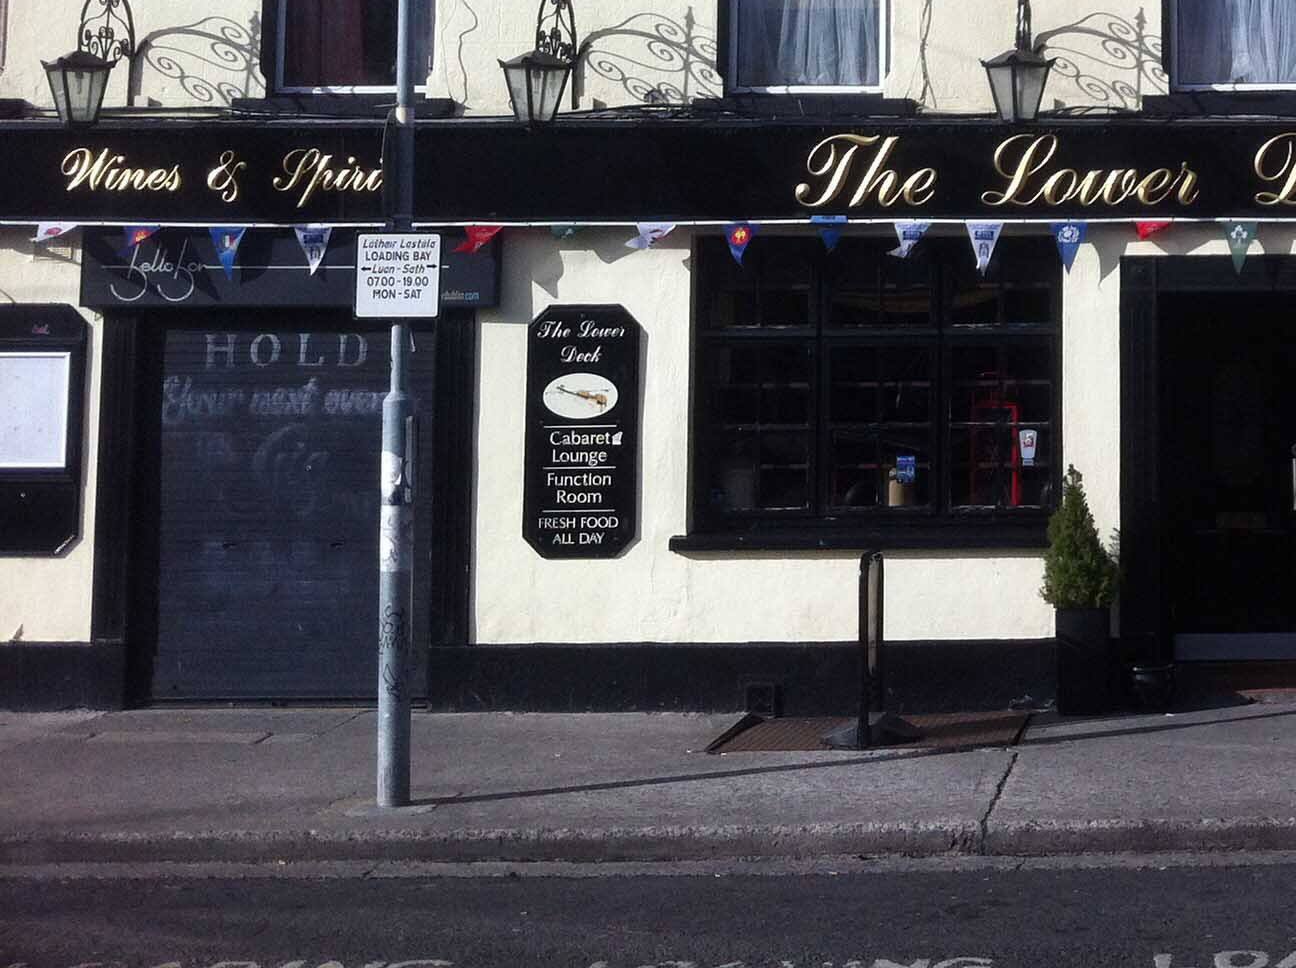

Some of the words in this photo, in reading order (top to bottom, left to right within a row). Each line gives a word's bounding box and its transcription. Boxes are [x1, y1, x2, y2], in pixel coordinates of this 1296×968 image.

[60, 147, 182, 192] Wines
[206, 150, 246, 202] &
[272, 148, 384, 208] Spiri
[795, 133, 937, 208] The
[981, 134, 1200, 206] Lower
[365, 251, 409, 261] LOADING
[413, 251, 431, 261] BAY
[371, 264, 395, 274] Luan
[372, 289, 396, 299] MON
[403, 289, 422, 299] SAT
[537, 321, 571, 338] The
[577, 320, 625, 338] Lower
[204, 333, 368, 368] HOLD
[560, 345, 602, 363] Deck
[550, 431, 610, 445] Cabaret
[552, 449, 607, 466] Lounge
[547, 472, 612, 486] Function
[556, 490, 602, 504] Room
[538, 517, 576, 529] FRESH
[580, 517, 619, 529] FOOD
[552, 532, 574, 544] ALL
[579, 532, 604, 544] DAY
